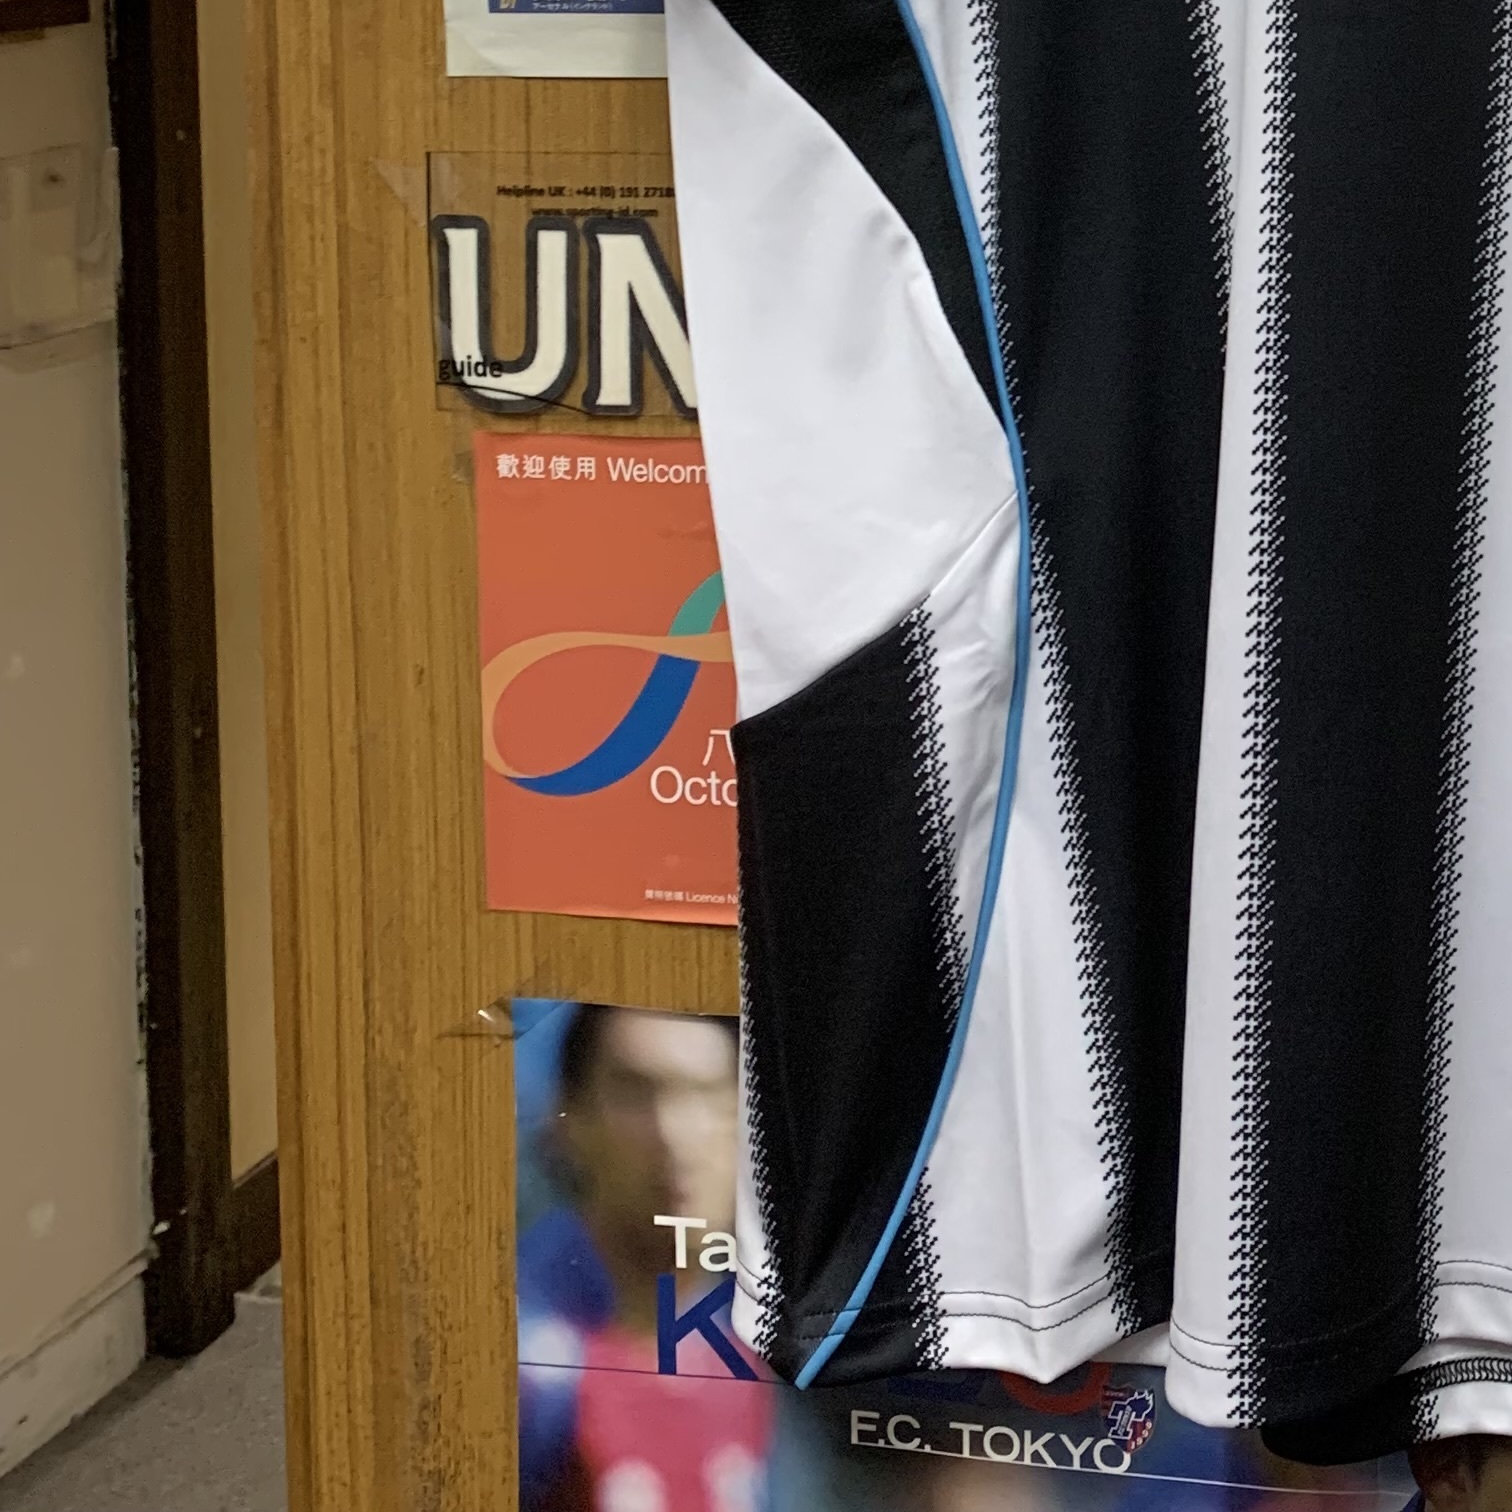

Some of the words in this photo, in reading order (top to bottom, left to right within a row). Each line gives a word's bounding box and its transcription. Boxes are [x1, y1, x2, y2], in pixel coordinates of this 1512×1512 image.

[438, 355, 503, 381] guide
[496, 453, 597, 482] 歡迎使用
[653, 1215, 737, 1273] Ta
[850, 1409, 932, 1451] F.C.
[949, 1421, 1132, 1475] TOKYO
